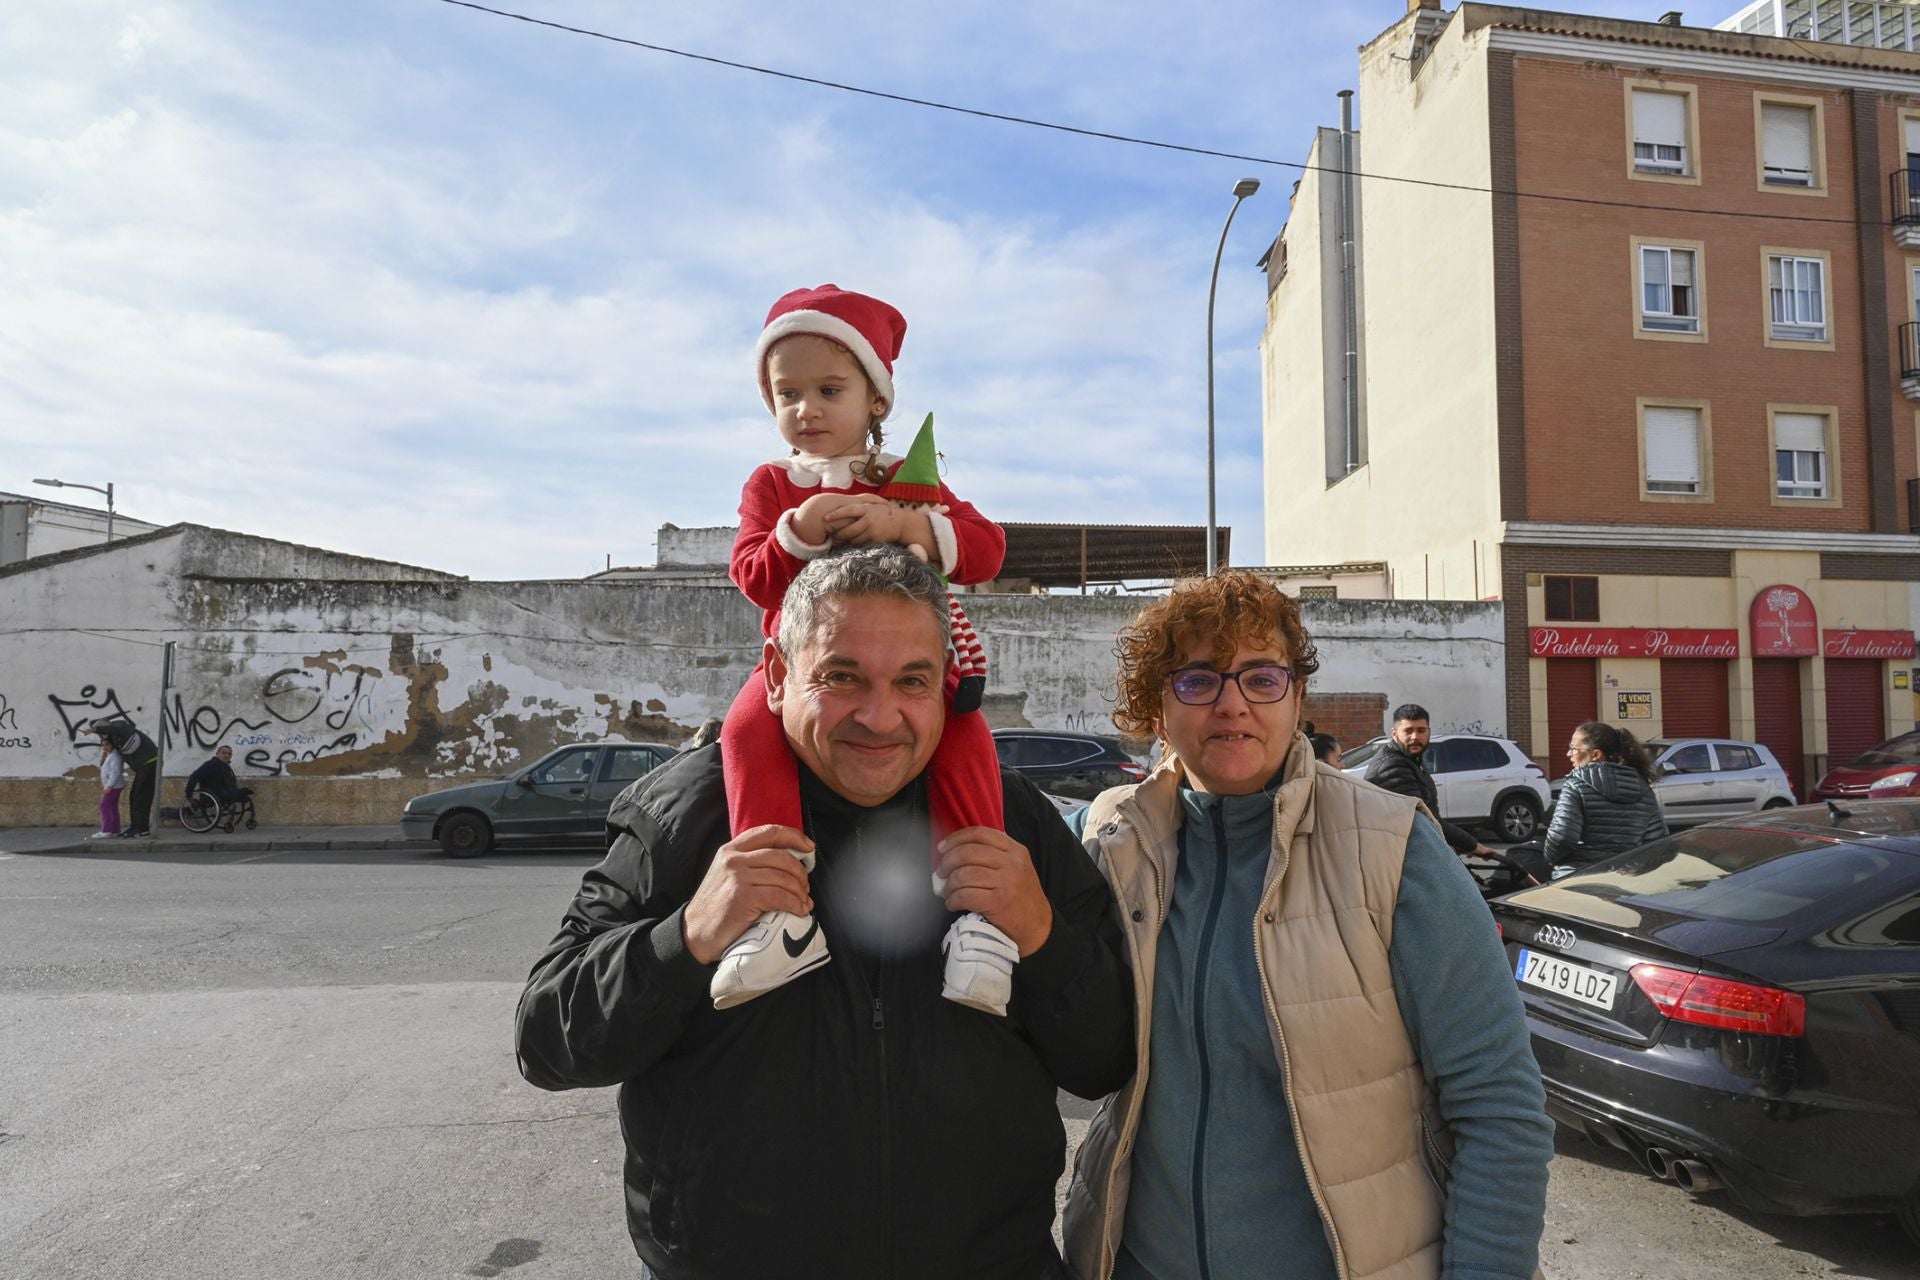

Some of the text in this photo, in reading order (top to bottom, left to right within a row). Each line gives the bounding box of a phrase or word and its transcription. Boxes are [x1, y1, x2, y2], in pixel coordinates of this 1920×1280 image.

[1534, 628, 1620, 655] Pastelería
[1645, 630, 1737, 656] Panadería
[1825, 631, 1913, 657] Tentación
[1618, 694, 1652, 703] SE VENDE
[1526, 957, 1612, 1004] 7419 LDZ
